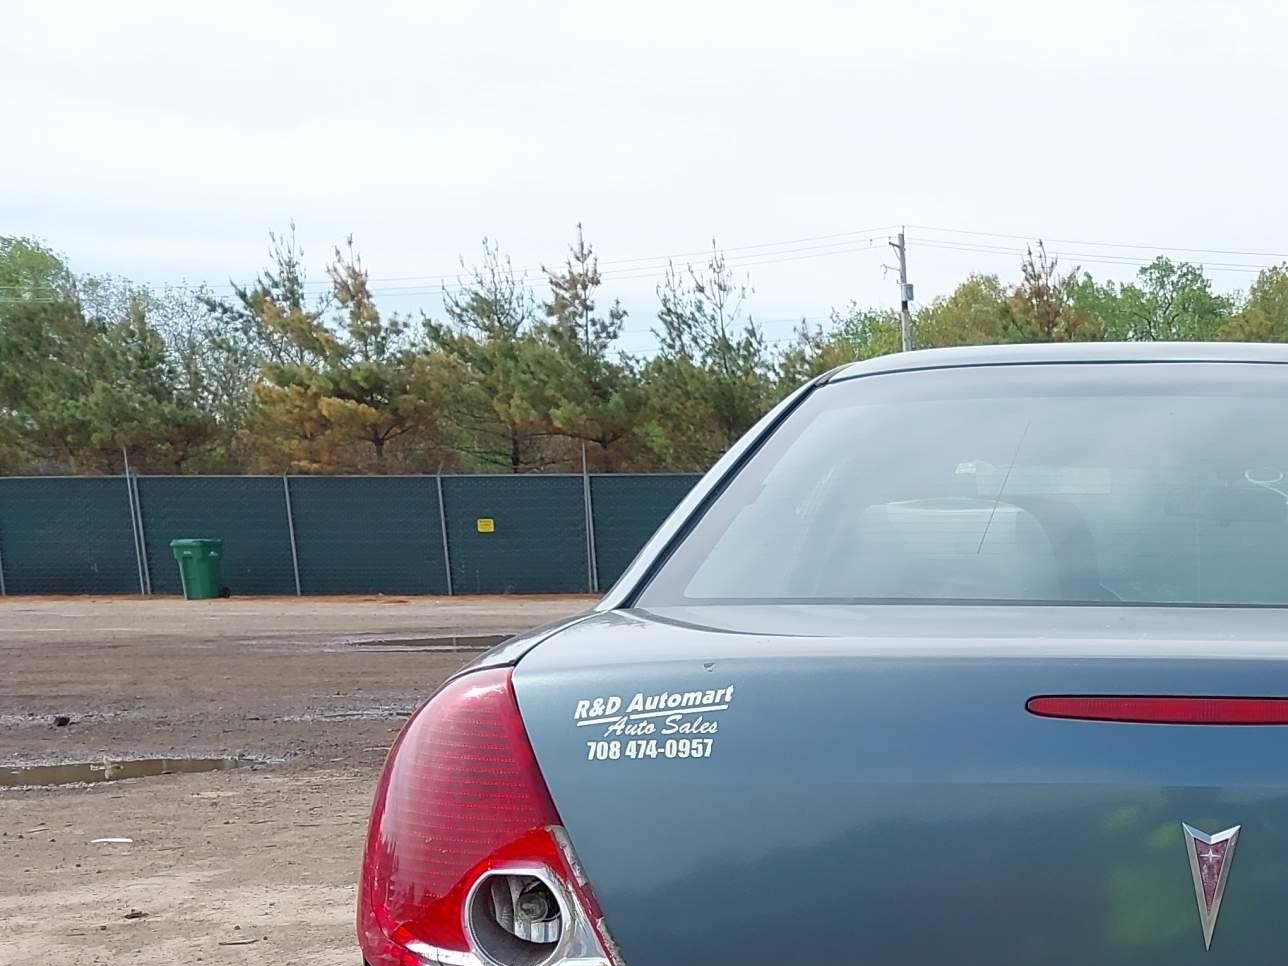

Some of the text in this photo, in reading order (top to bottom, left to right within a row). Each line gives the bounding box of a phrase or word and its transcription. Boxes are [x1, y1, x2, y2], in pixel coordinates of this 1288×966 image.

[574, 684, 735, 719] R&D Automart
[604, 714, 719, 737] Auto Sales
[586, 738, 714, 760] 708 474-0957
